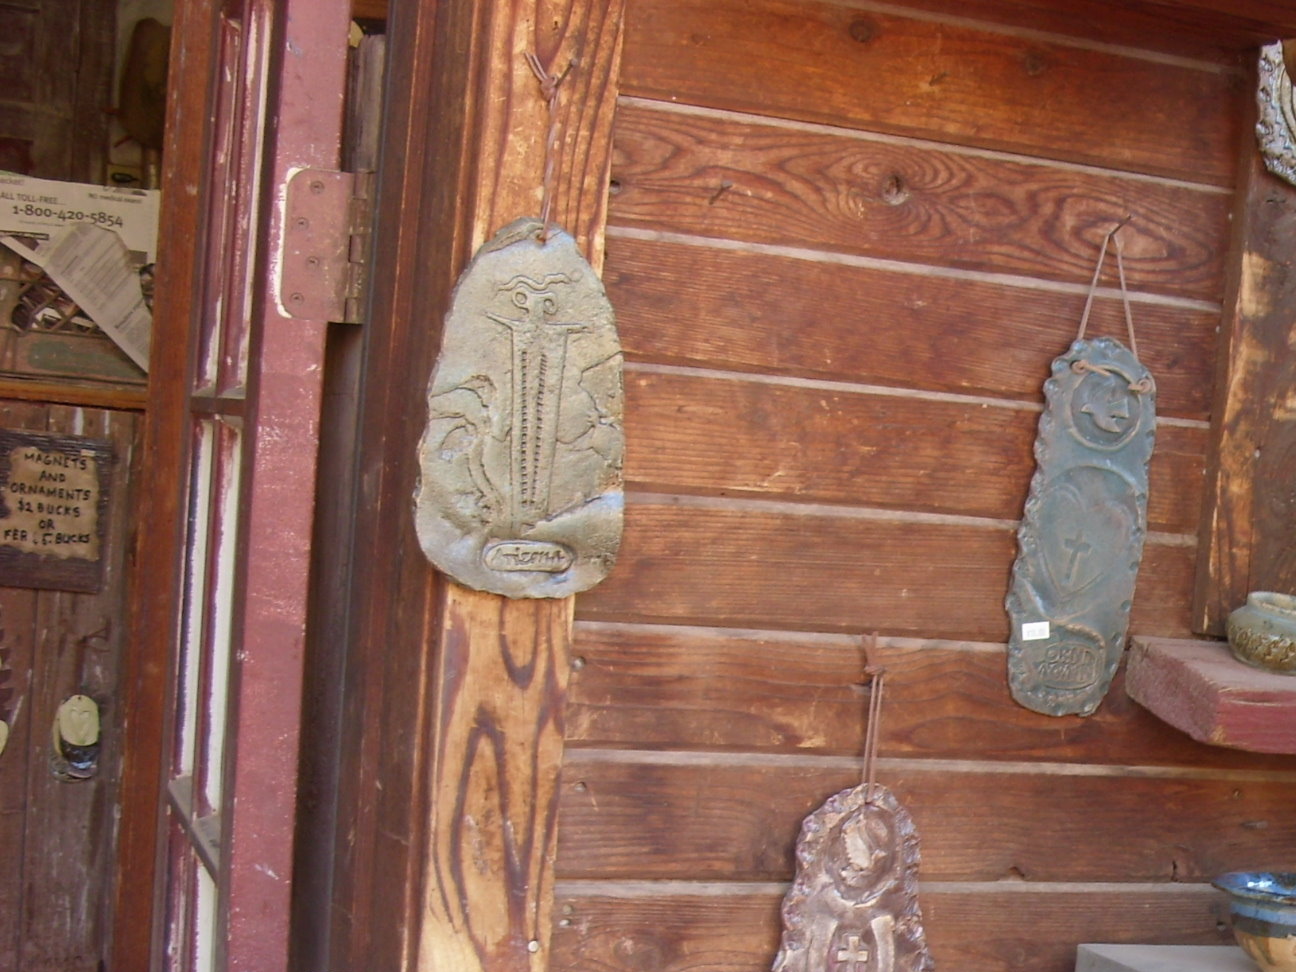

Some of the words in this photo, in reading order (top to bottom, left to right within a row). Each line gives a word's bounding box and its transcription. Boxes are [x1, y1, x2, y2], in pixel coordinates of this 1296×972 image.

[16, 192, 36, 203] TOLL
[13, 204, 124, 229] 1-800-420-5854
[24, 453, 88, 471] MAGNETS
[39, 470, 66, 483] AND
[9, 482, 92, 501] ORNAMENTS
[37, 503, 80, 518] BUCKS
[39, 518, 55, 530] OR
[55, 532, 91, 545] BUCKS
